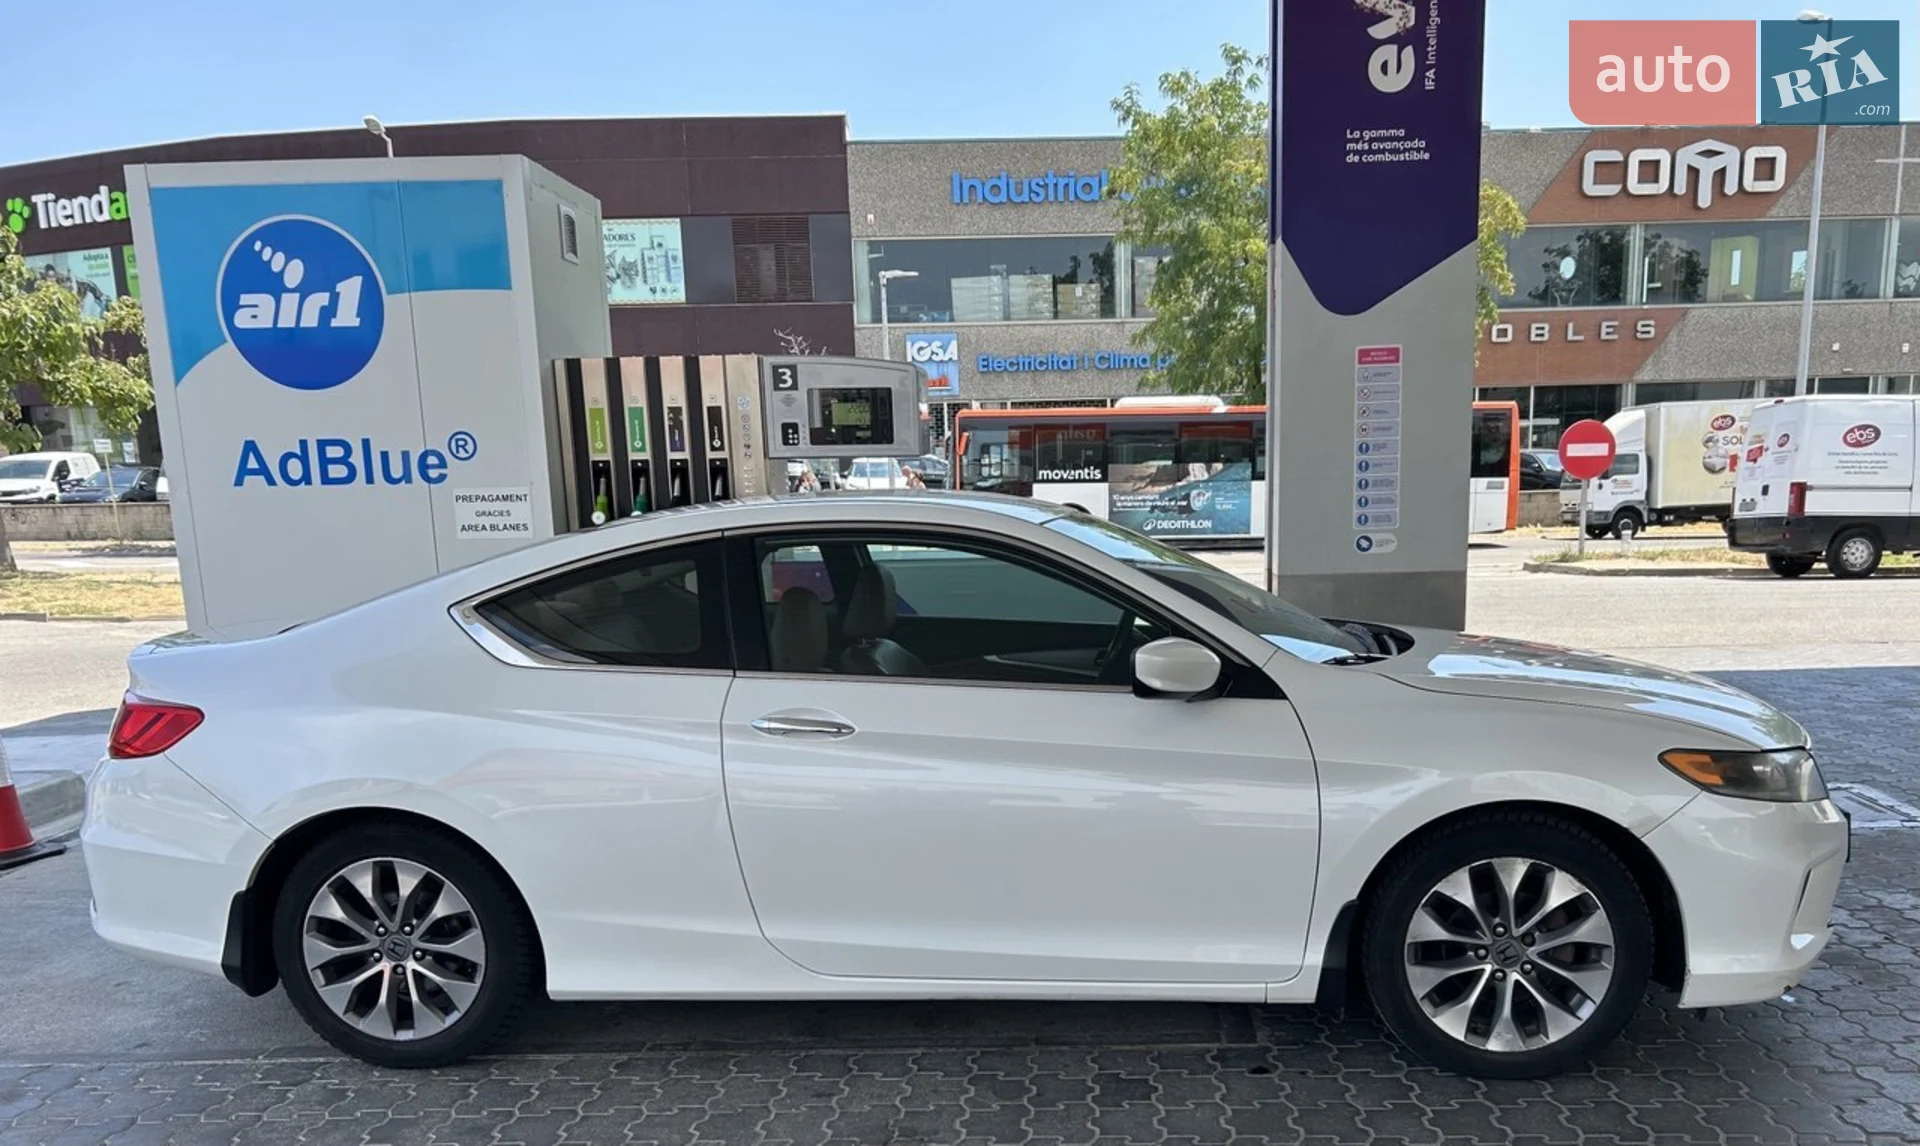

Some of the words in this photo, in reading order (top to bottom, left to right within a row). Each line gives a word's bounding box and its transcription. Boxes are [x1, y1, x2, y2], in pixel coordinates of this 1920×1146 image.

[1425, 68, 1437, 90] IFA
[1346, 129, 1359, 139] La
[1362, 129, 1405, 140] gamma
[1346, 141, 1369, 150] més
[1371, 139, 1426, 151] avançada
[1346, 152, 1359, 163] de
[1361, 150, 1430, 163] combustible
[1582, 140, 1788, 209] COMO
[951, 169, 1109, 204] Industrial
[31, 185, 129, 229] Tienda
[233, 275, 363, 329] air1
[1489, 319, 1657, 344] OBLES
[906, 340, 958, 362] IGSA
[978, 354, 1077, 374] Electricitat
[1094, 351, 1150, 370] Clima
[777, 368, 793, 388] 3
[1846, 428, 1875, 444] ebs
[455, 493, 528, 503] PREPAGAMENT
[460, 524, 487, 532] AREA
[489, 523, 528, 532] BLANES
